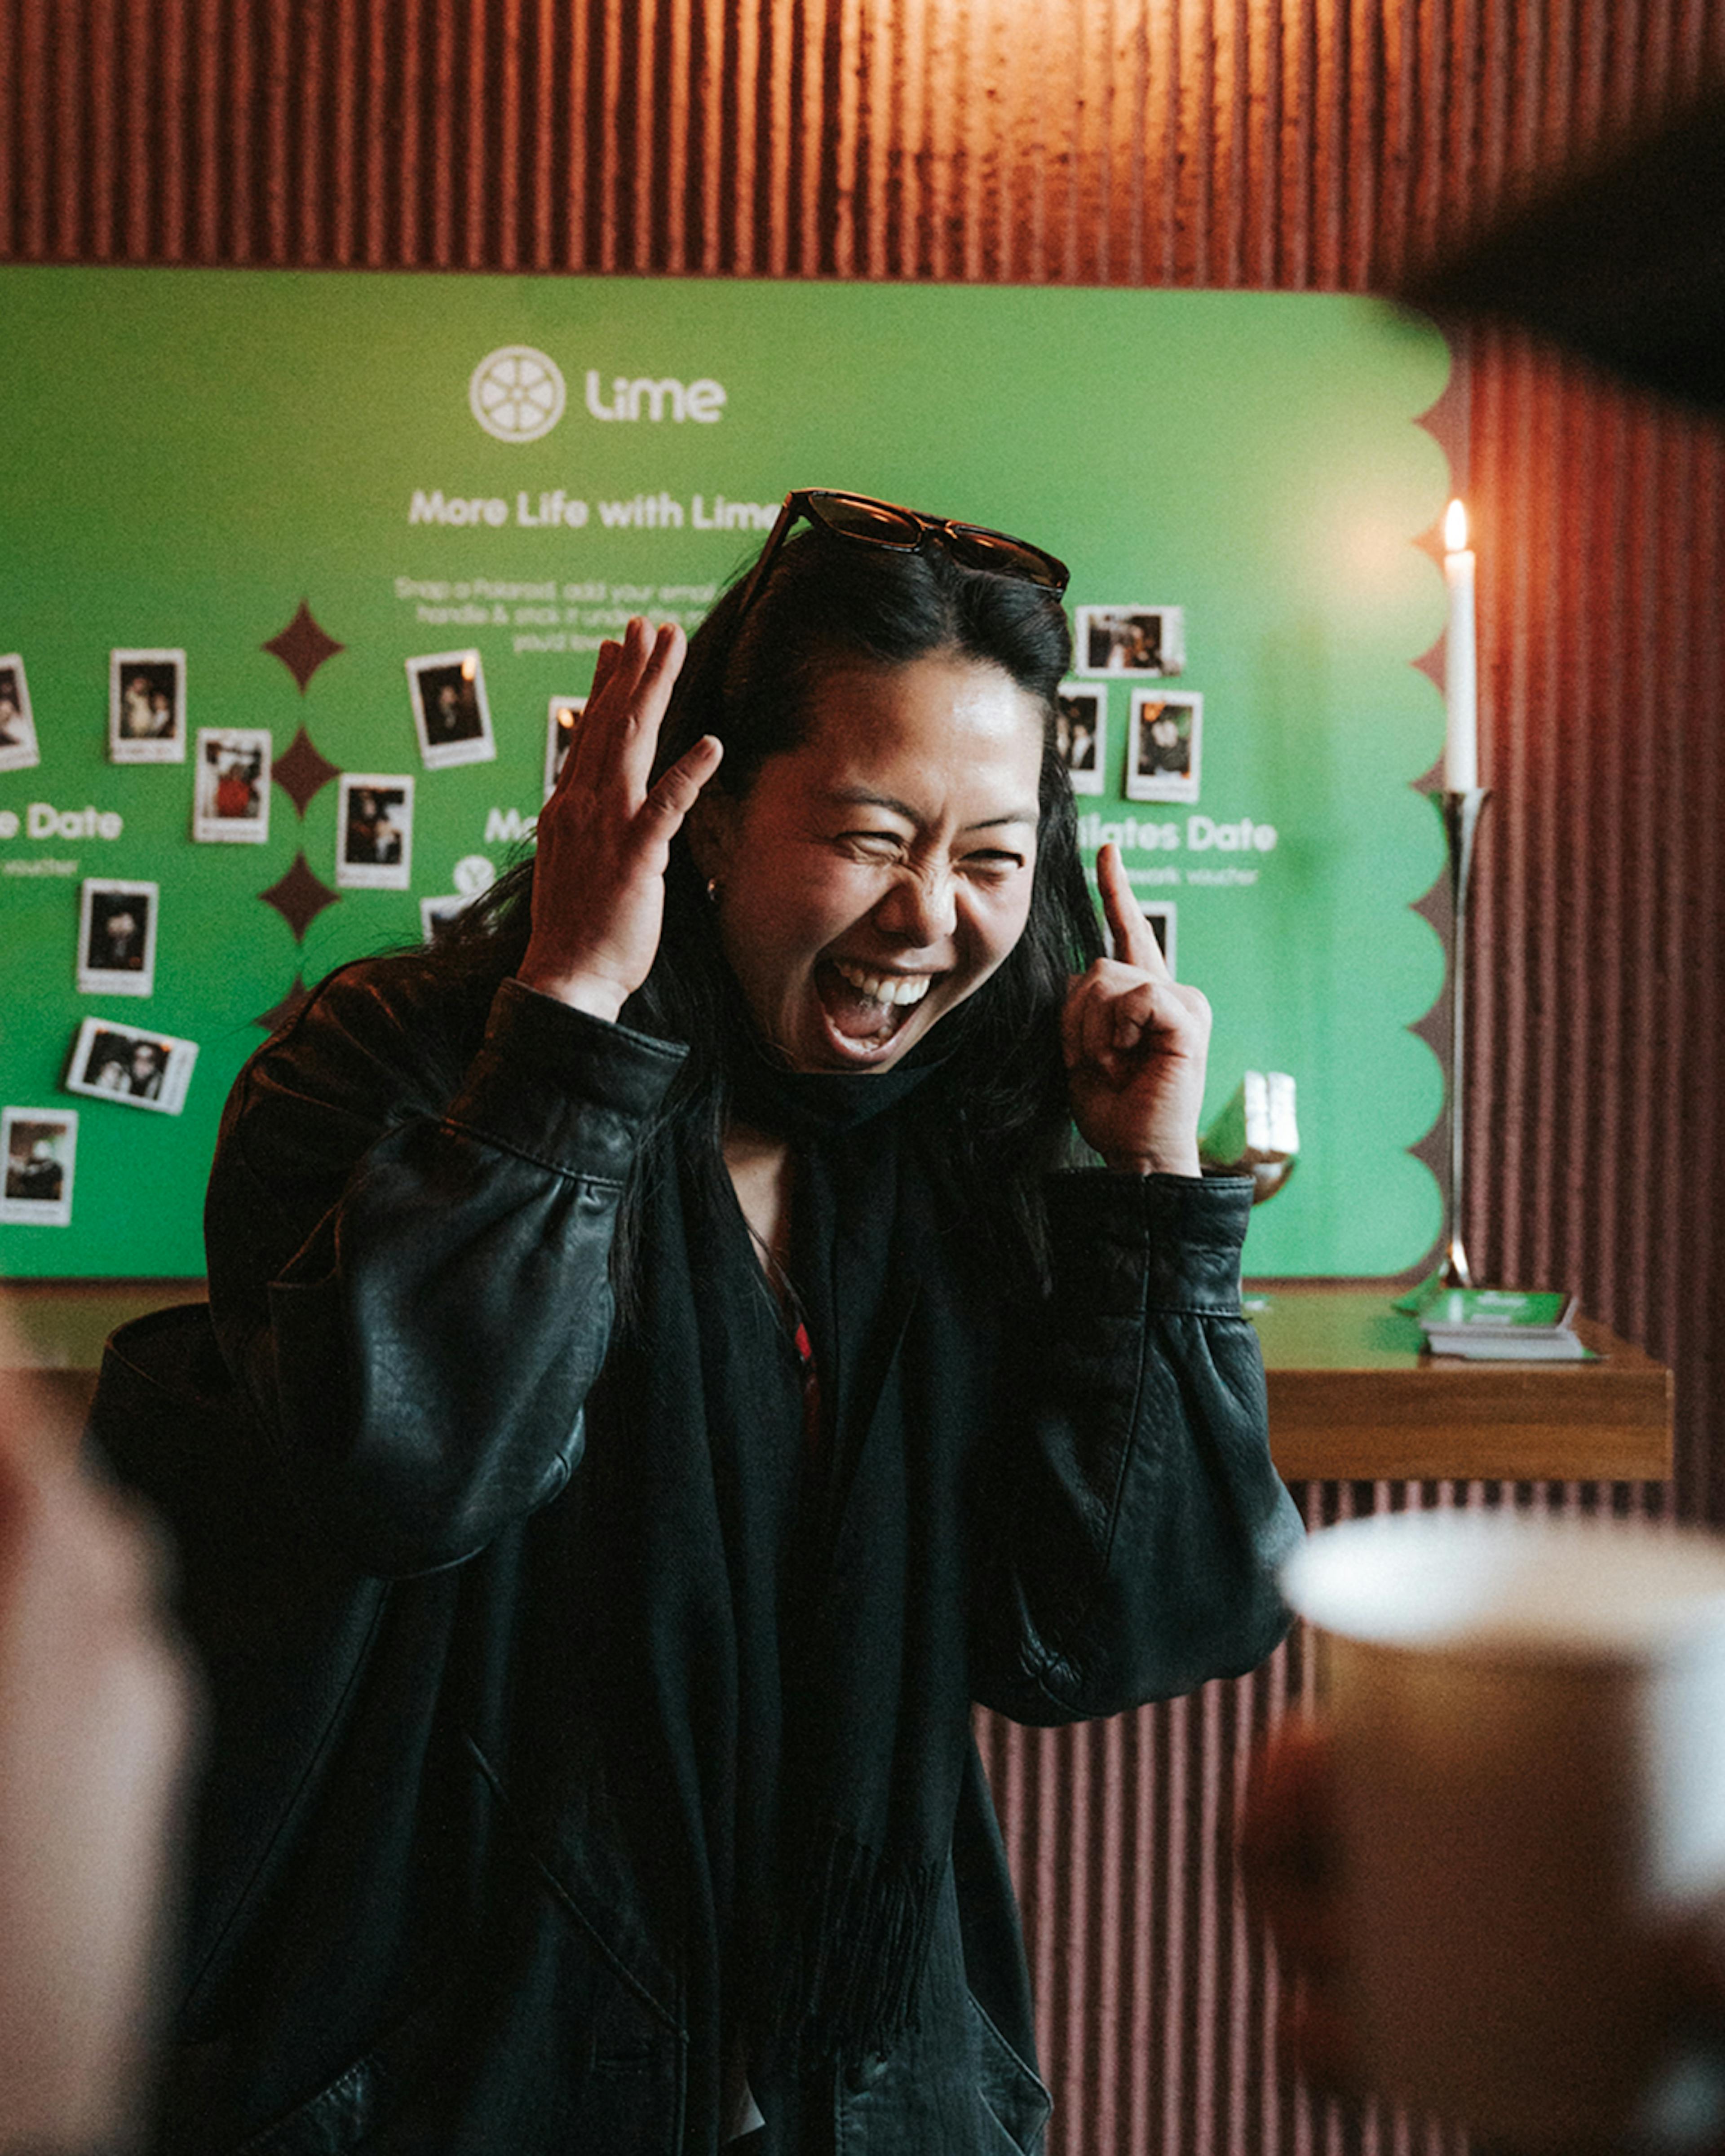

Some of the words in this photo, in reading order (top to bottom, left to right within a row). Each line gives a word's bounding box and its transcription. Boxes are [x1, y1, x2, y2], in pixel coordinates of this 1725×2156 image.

[585, 370, 726, 422] Lime
[409, 490, 507, 526] More
[517, 490, 588, 527] Life
[598, 492, 684, 528] with
[27, 802, 124, 841] Date
[1187, 814, 1278, 853] Date
